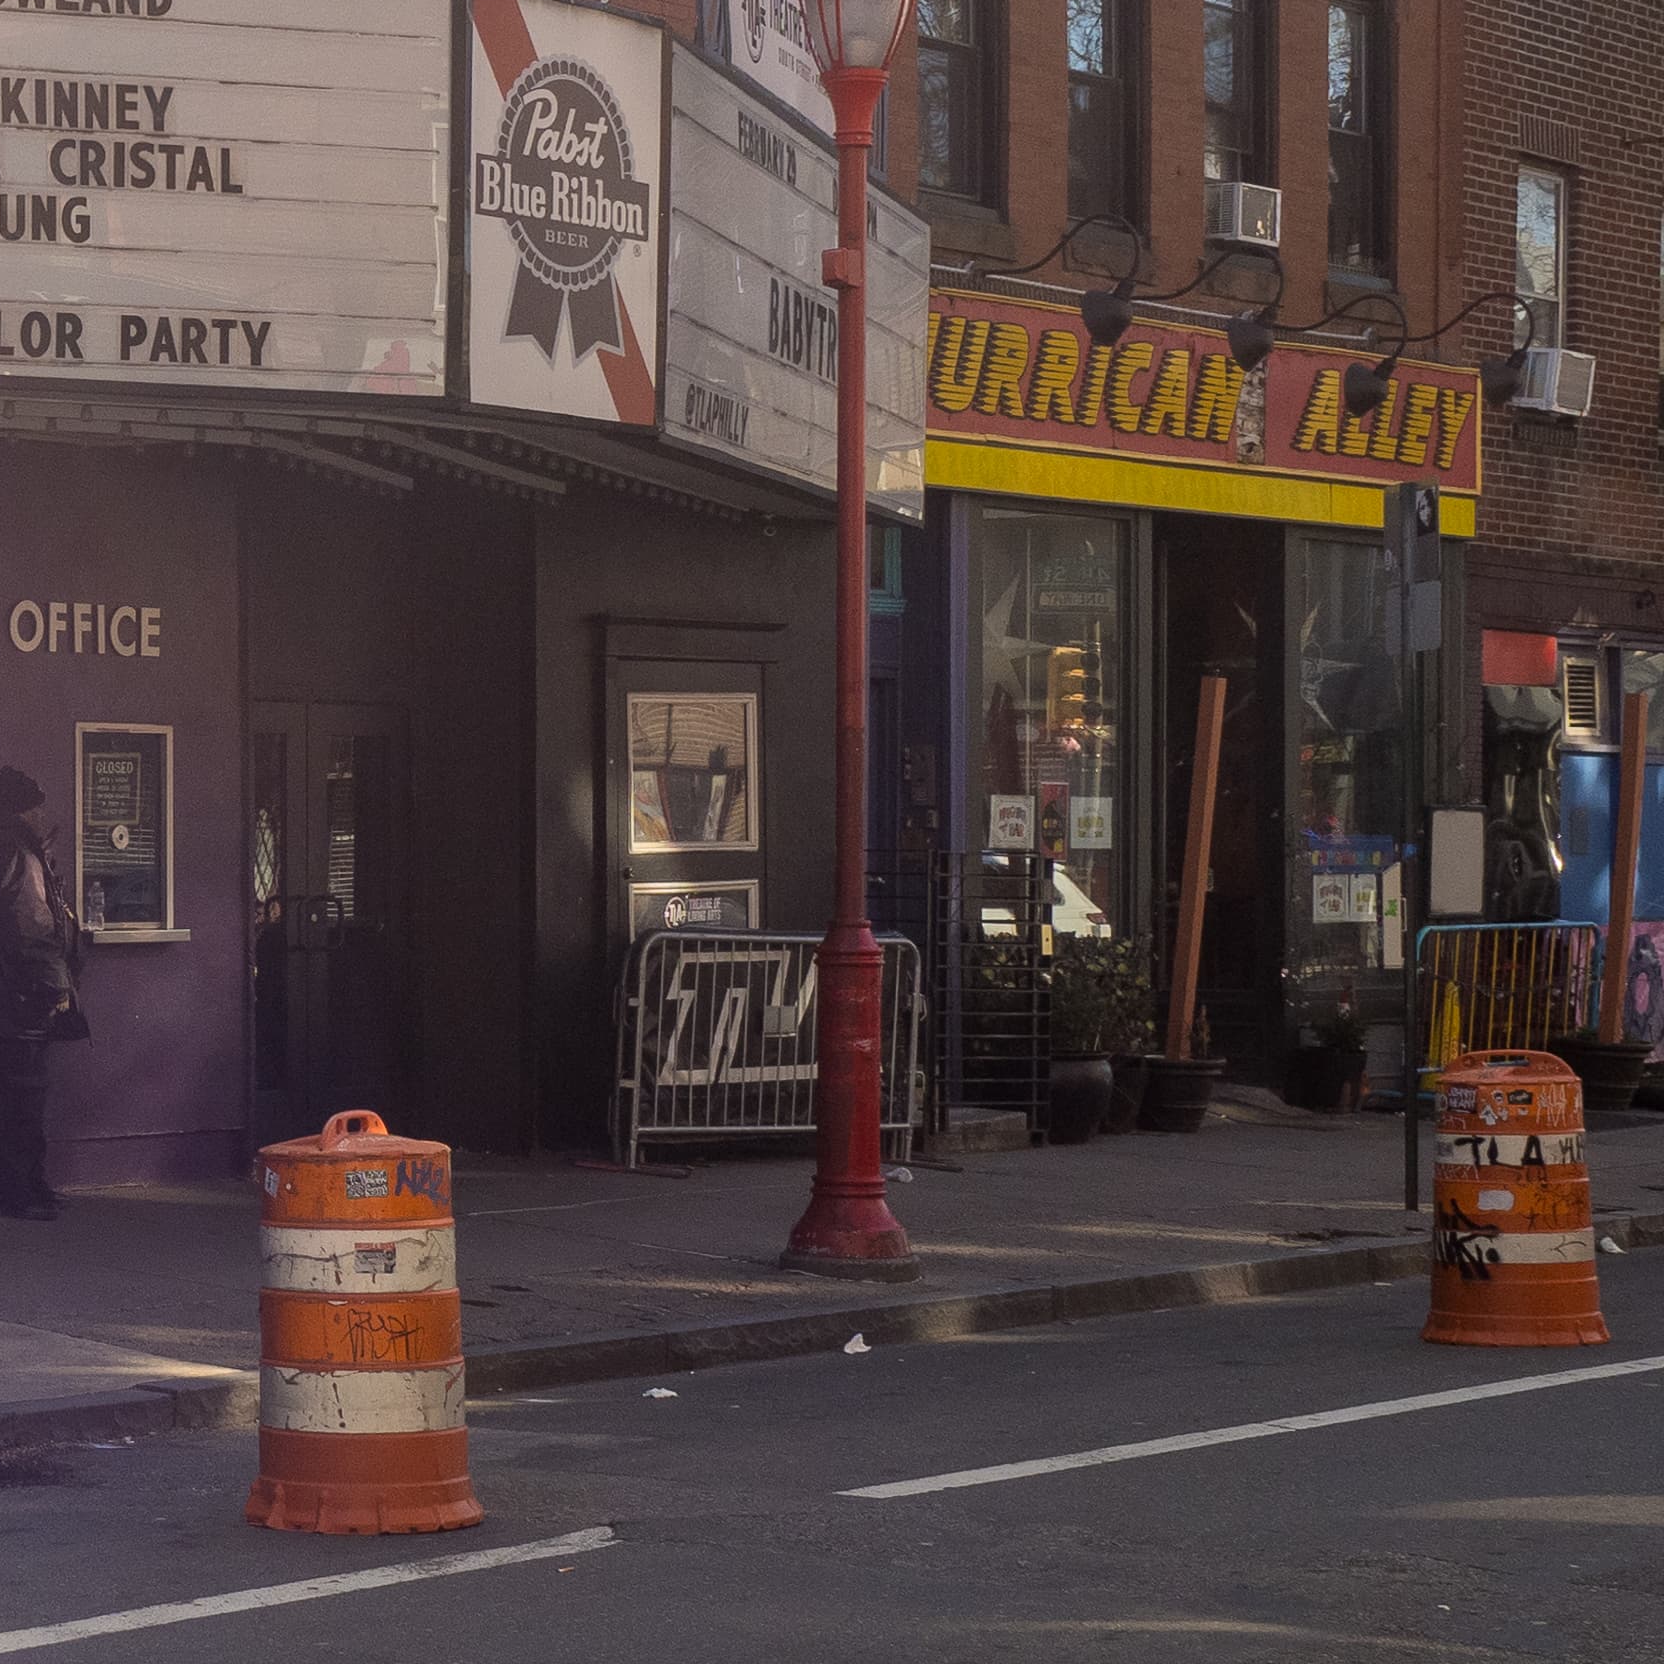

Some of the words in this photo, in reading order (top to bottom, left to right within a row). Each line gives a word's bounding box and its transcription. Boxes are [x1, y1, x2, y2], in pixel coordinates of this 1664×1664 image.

[2, 78, 173, 132] KINNEY
[522, 89, 608, 170] Pabst
[50, 138, 243, 193] CRISTAL
[737, 110, 784, 178] FEBRUARY
[479, 159, 547, 219] Blue
[550, 171, 644, 237] Ribbon
[544, 228, 589, 250] BEER
[121, 316, 271, 365] PARTY
[767, 277, 839, 382] BABYTR
[684, 382, 750, 446] @TLAPHILLY
[10, 600, 162, 657] OFFICE
[95, 761, 134, 774] CLOSED
